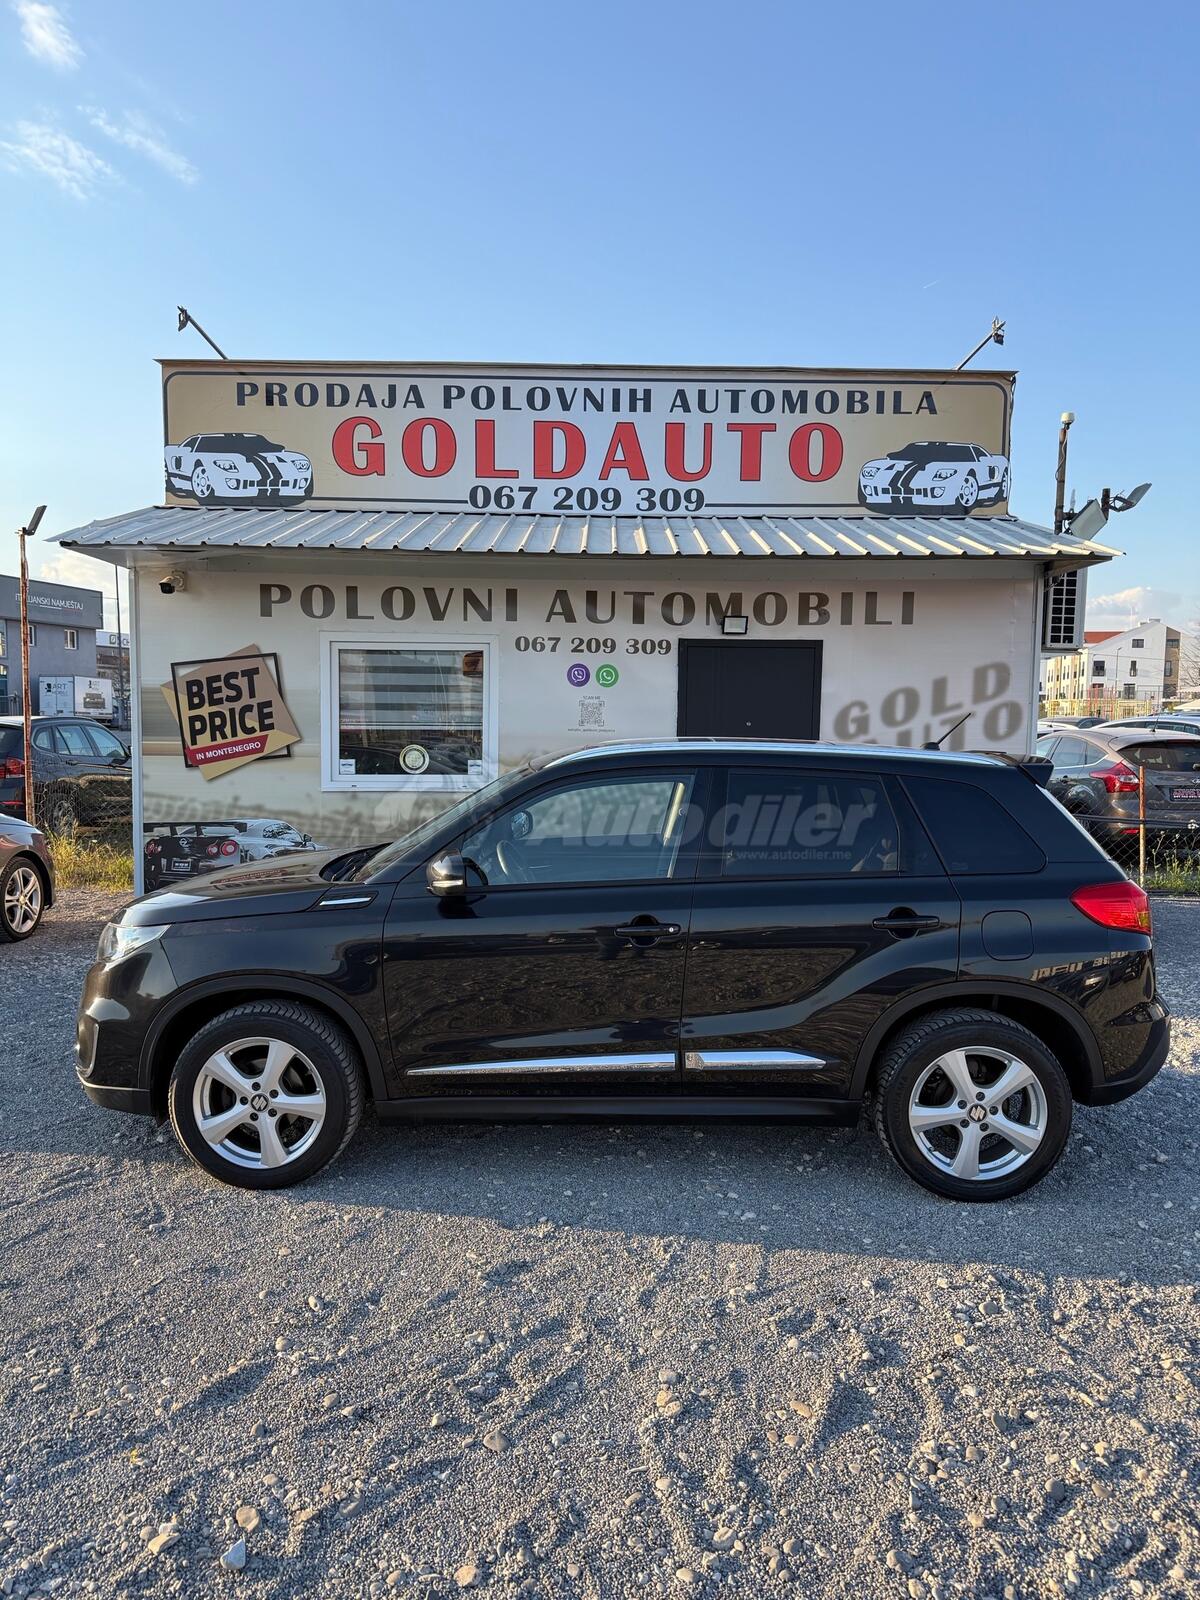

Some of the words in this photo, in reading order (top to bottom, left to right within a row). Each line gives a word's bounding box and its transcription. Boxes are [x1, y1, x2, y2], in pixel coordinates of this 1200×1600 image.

[236, 382, 426, 409] PRODAJA
[443, 385, 652, 413] POLOVNIH
[669, 389, 938, 415] AUTOMOBILA
[331, 416, 844, 483] GOLDAUTO
[469, 485, 539, 511] 067
[553, 486, 622, 511] 209
[636, 488, 706, 512] 309
[259, 583, 518, 622] POLOVNI
[545, 590, 915, 626] AUTOMOBILI
[515, 636, 561, 653] 067
[571, 637, 617, 654] 209
[625, 638, 672, 655] 309
[186, 666, 260, 711] BEST
[833, 661, 1012, 740] GOLD
[188, 700, 275, 746] PRICE
[196, 752, 205, 760] IN
[206, 741, 261, 759] MONTENEGRO
